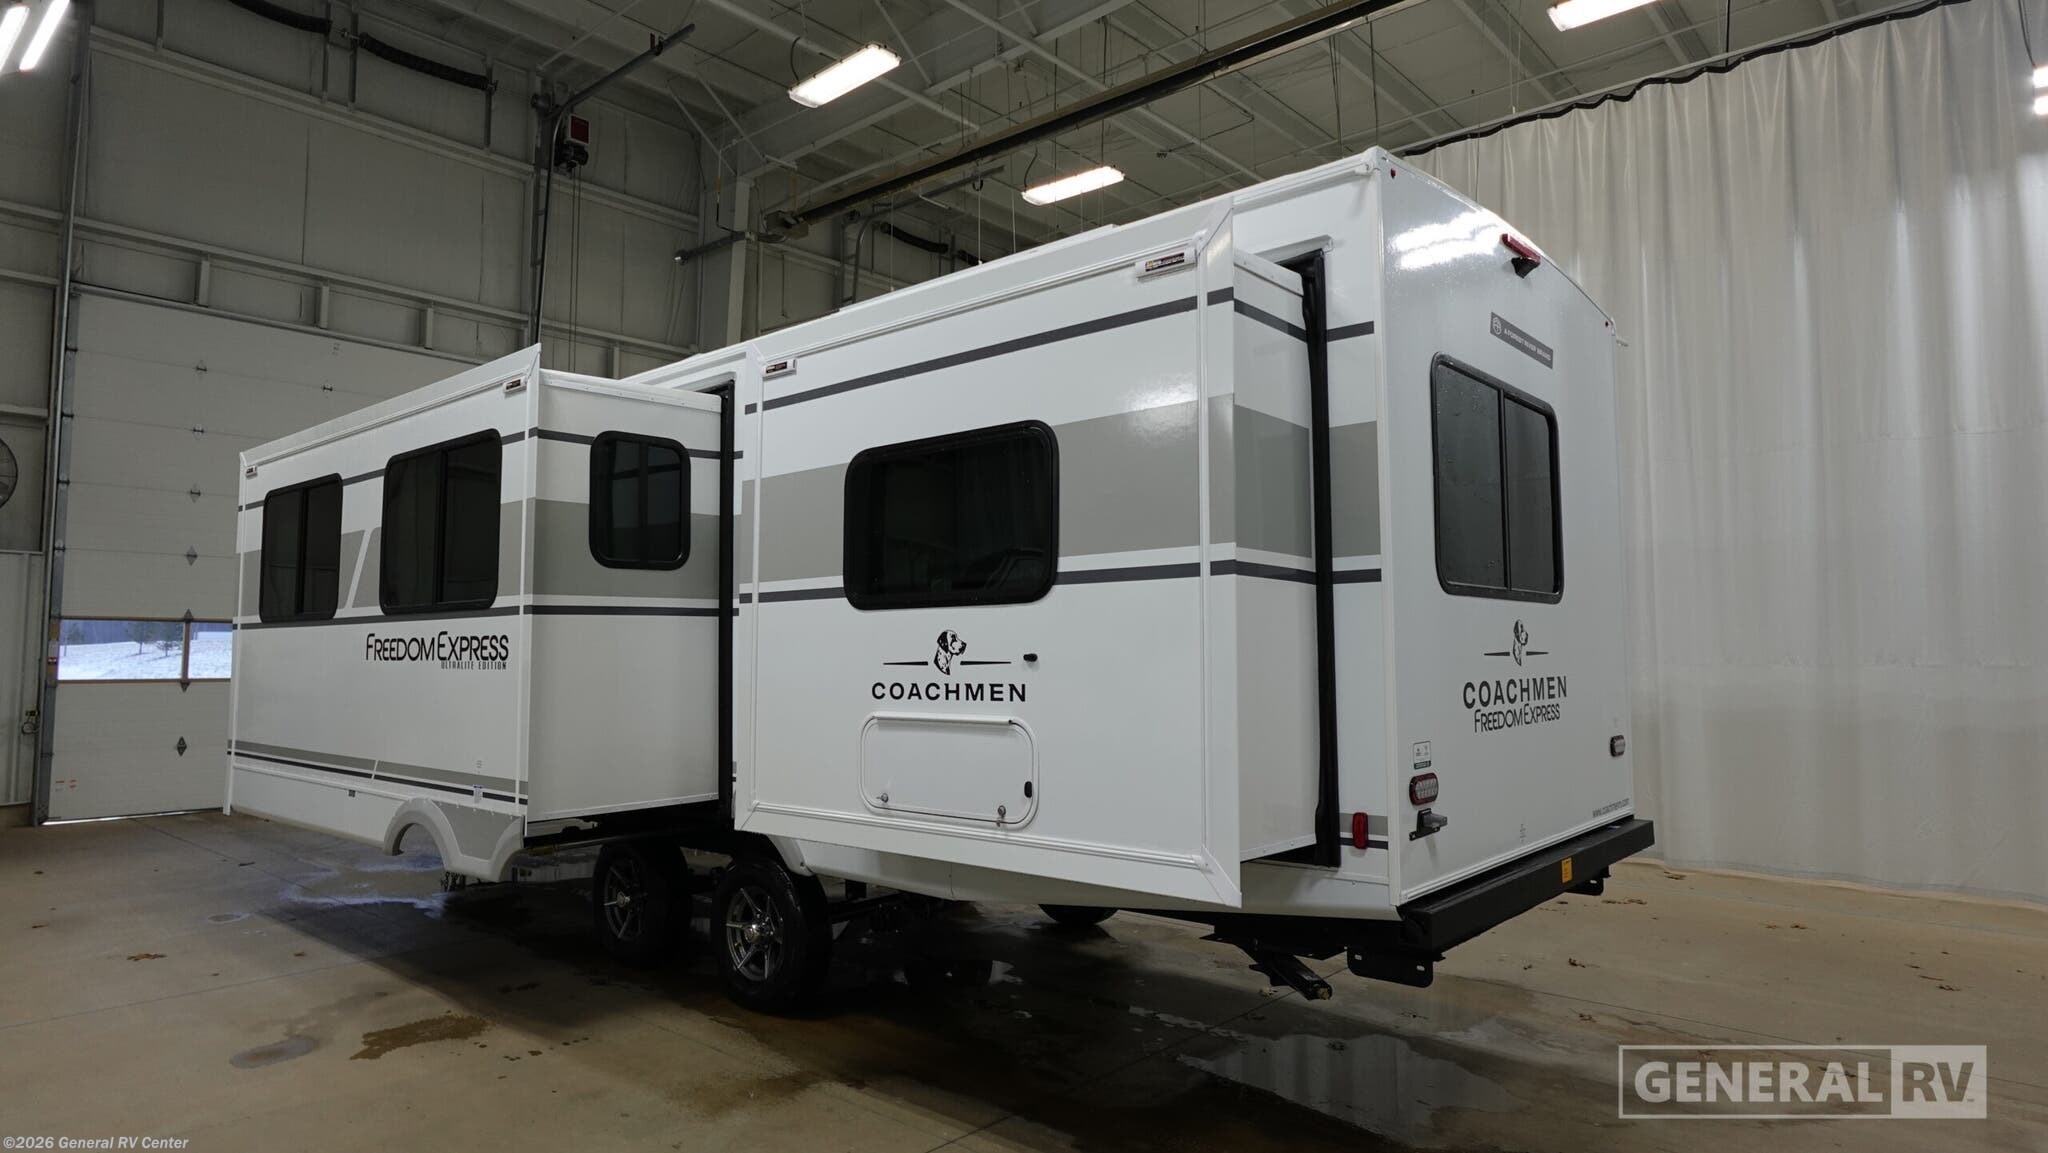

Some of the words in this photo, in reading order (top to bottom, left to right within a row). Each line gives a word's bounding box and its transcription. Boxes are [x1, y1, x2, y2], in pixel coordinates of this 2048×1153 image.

[478, 661, 507, 671] EDITION
[871, 682, 1027, 702] COACHMEN
[1463, 675, 1568, 709] COACHMEN
